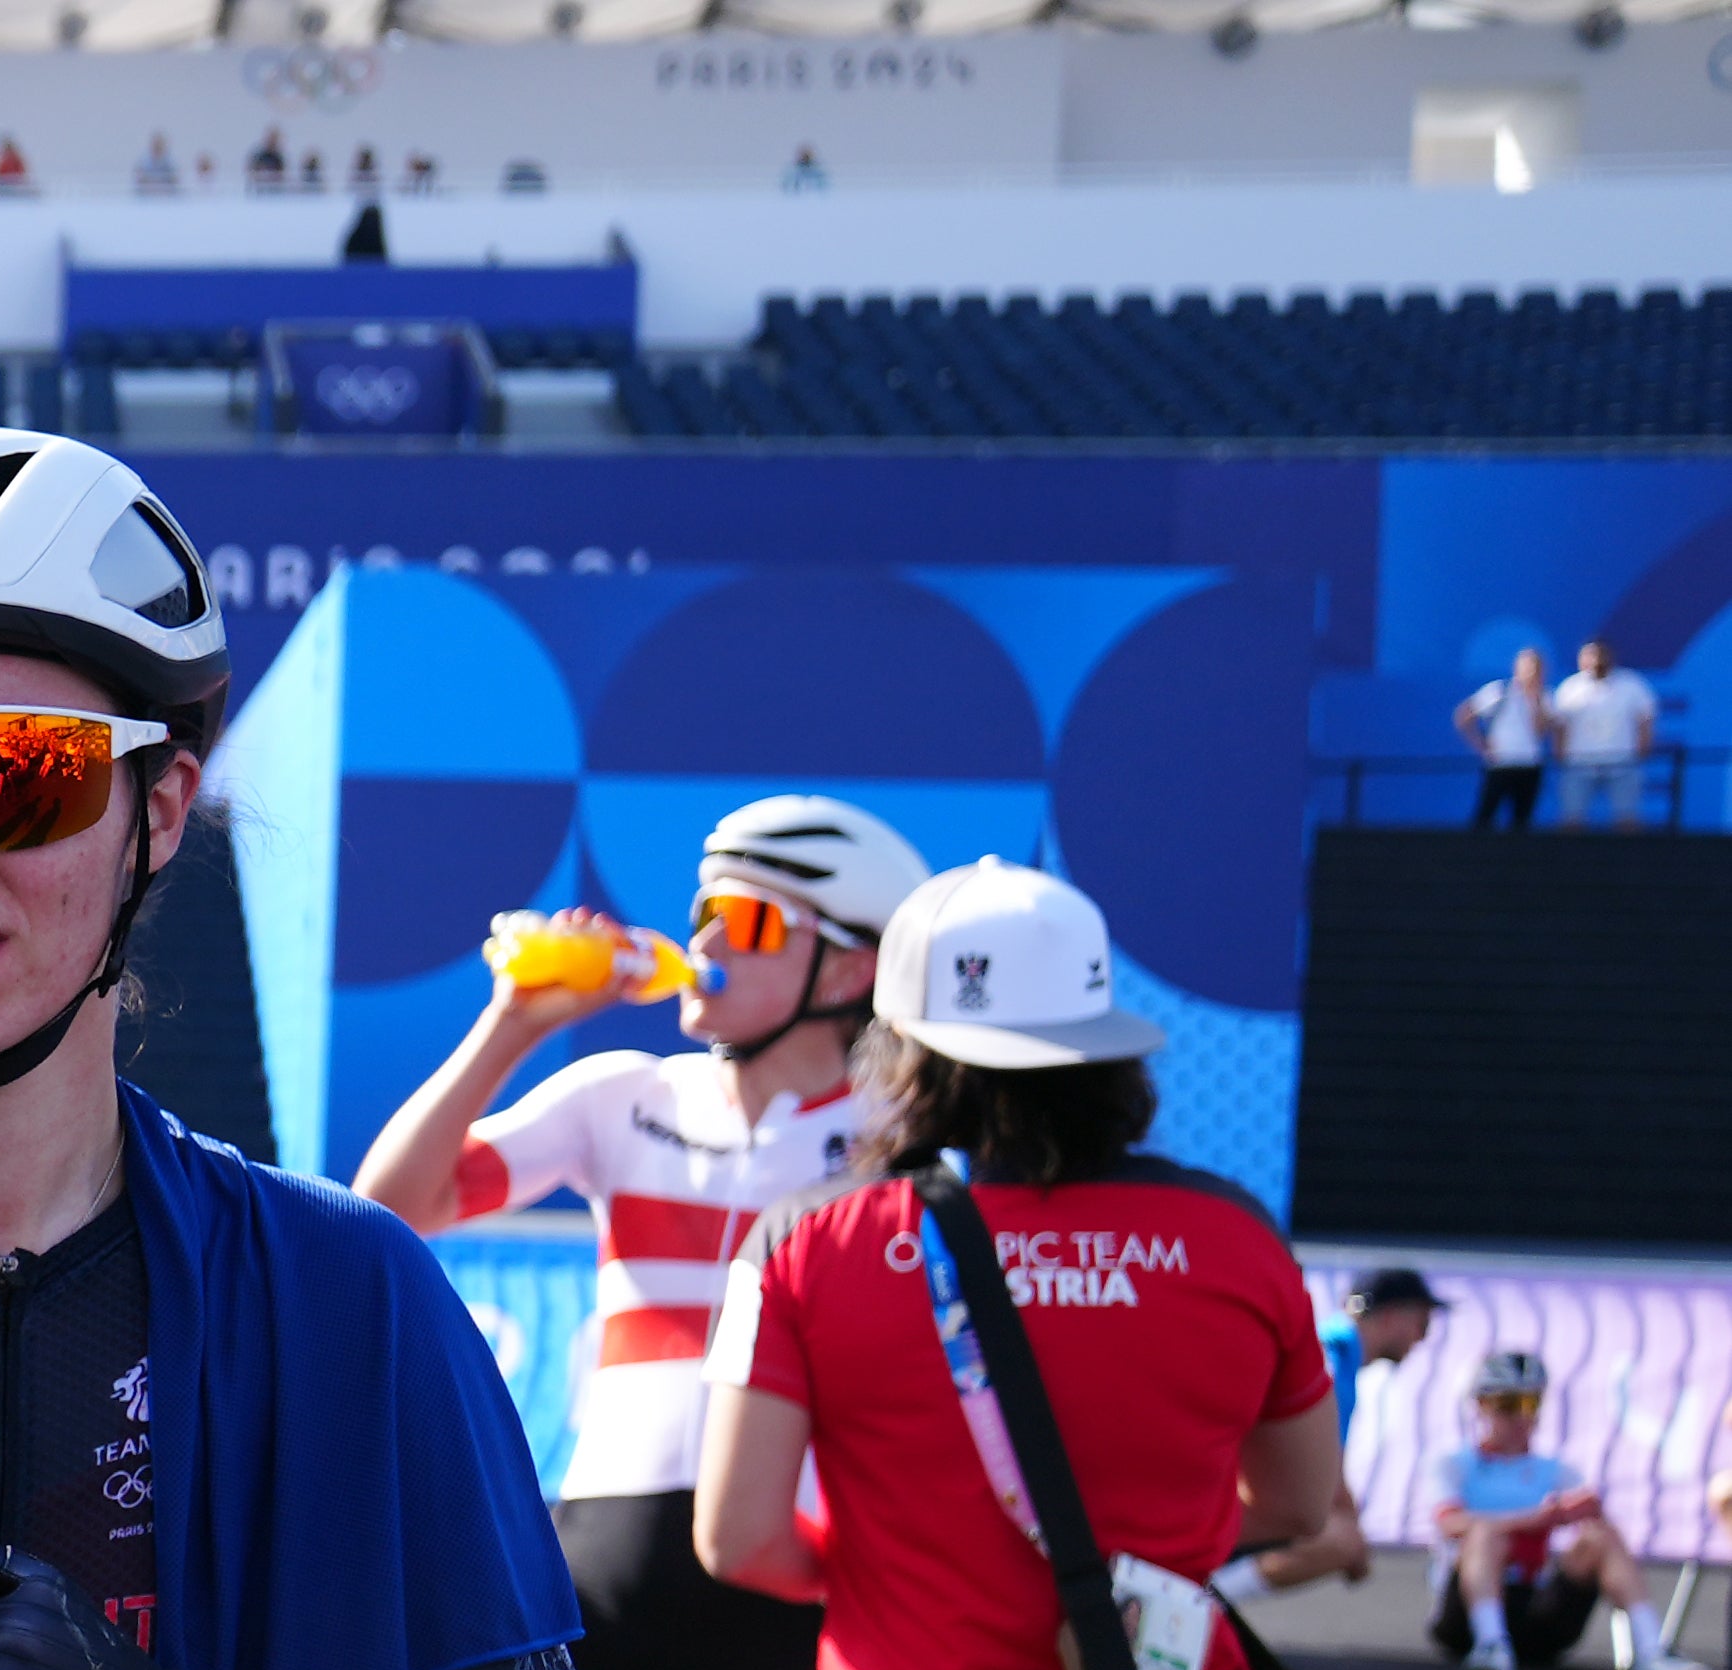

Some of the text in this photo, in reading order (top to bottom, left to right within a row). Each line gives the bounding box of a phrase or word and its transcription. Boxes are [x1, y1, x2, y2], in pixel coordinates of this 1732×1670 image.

[885, 1231, 1190, 1275] OPIC TEAM
[1004, 1266, 1139, 1308] STRIA
